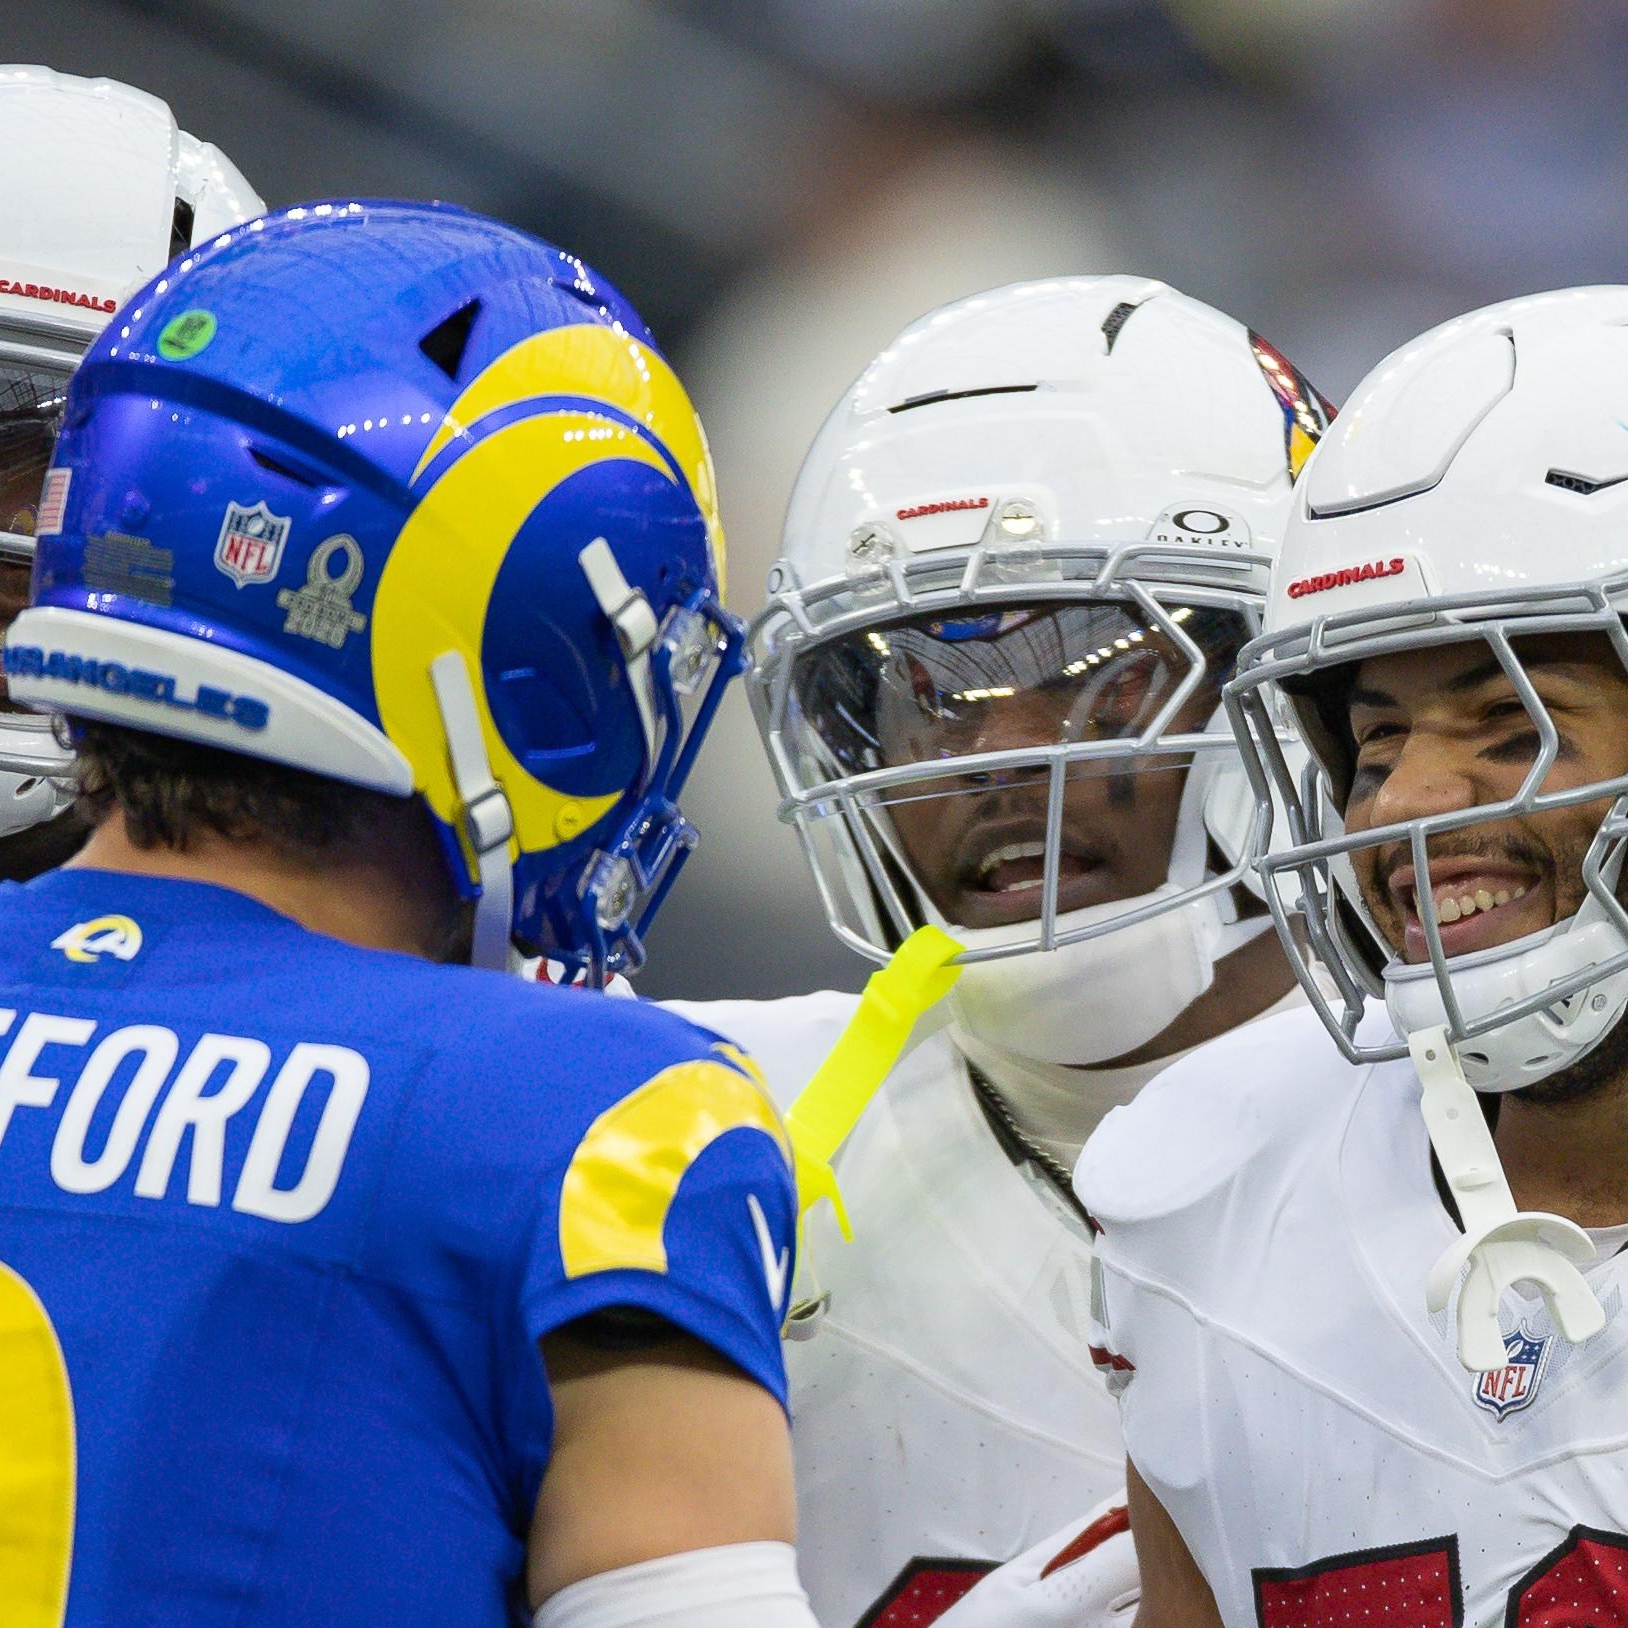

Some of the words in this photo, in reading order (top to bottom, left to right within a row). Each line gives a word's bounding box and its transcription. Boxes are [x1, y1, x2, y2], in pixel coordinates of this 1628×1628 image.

[225, 535, 269, 574] NFL
[1287, 557, 1405, 599] CARDINALS
[1481, 1365, 1527, 1402] NFL
